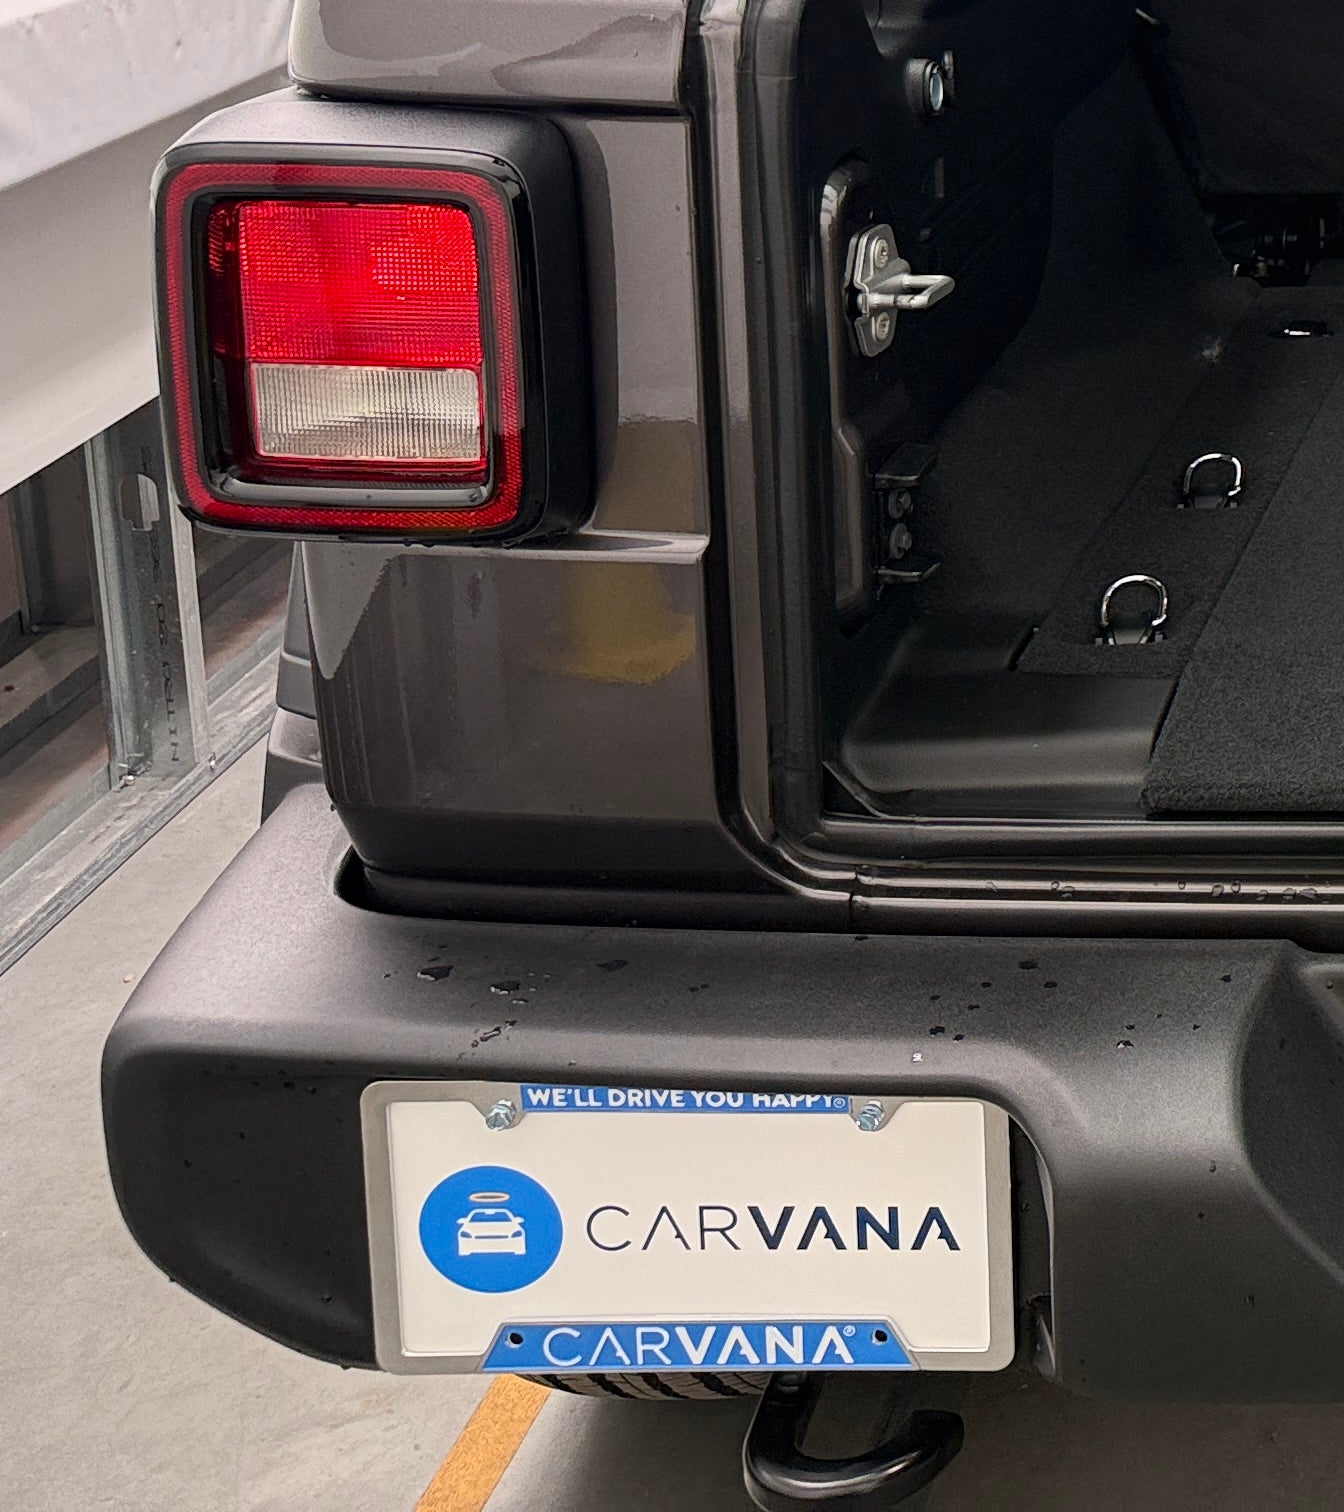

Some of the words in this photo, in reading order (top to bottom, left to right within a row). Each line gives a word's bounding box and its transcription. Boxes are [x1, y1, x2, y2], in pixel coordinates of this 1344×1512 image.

[527, 1088, 603, 1107] WE'LL
[608, 1089, 687, 1108] DRIVE
[690, 1090, 744, 1107] YOU
[586, 1204, 961, 1251] CARVANA
